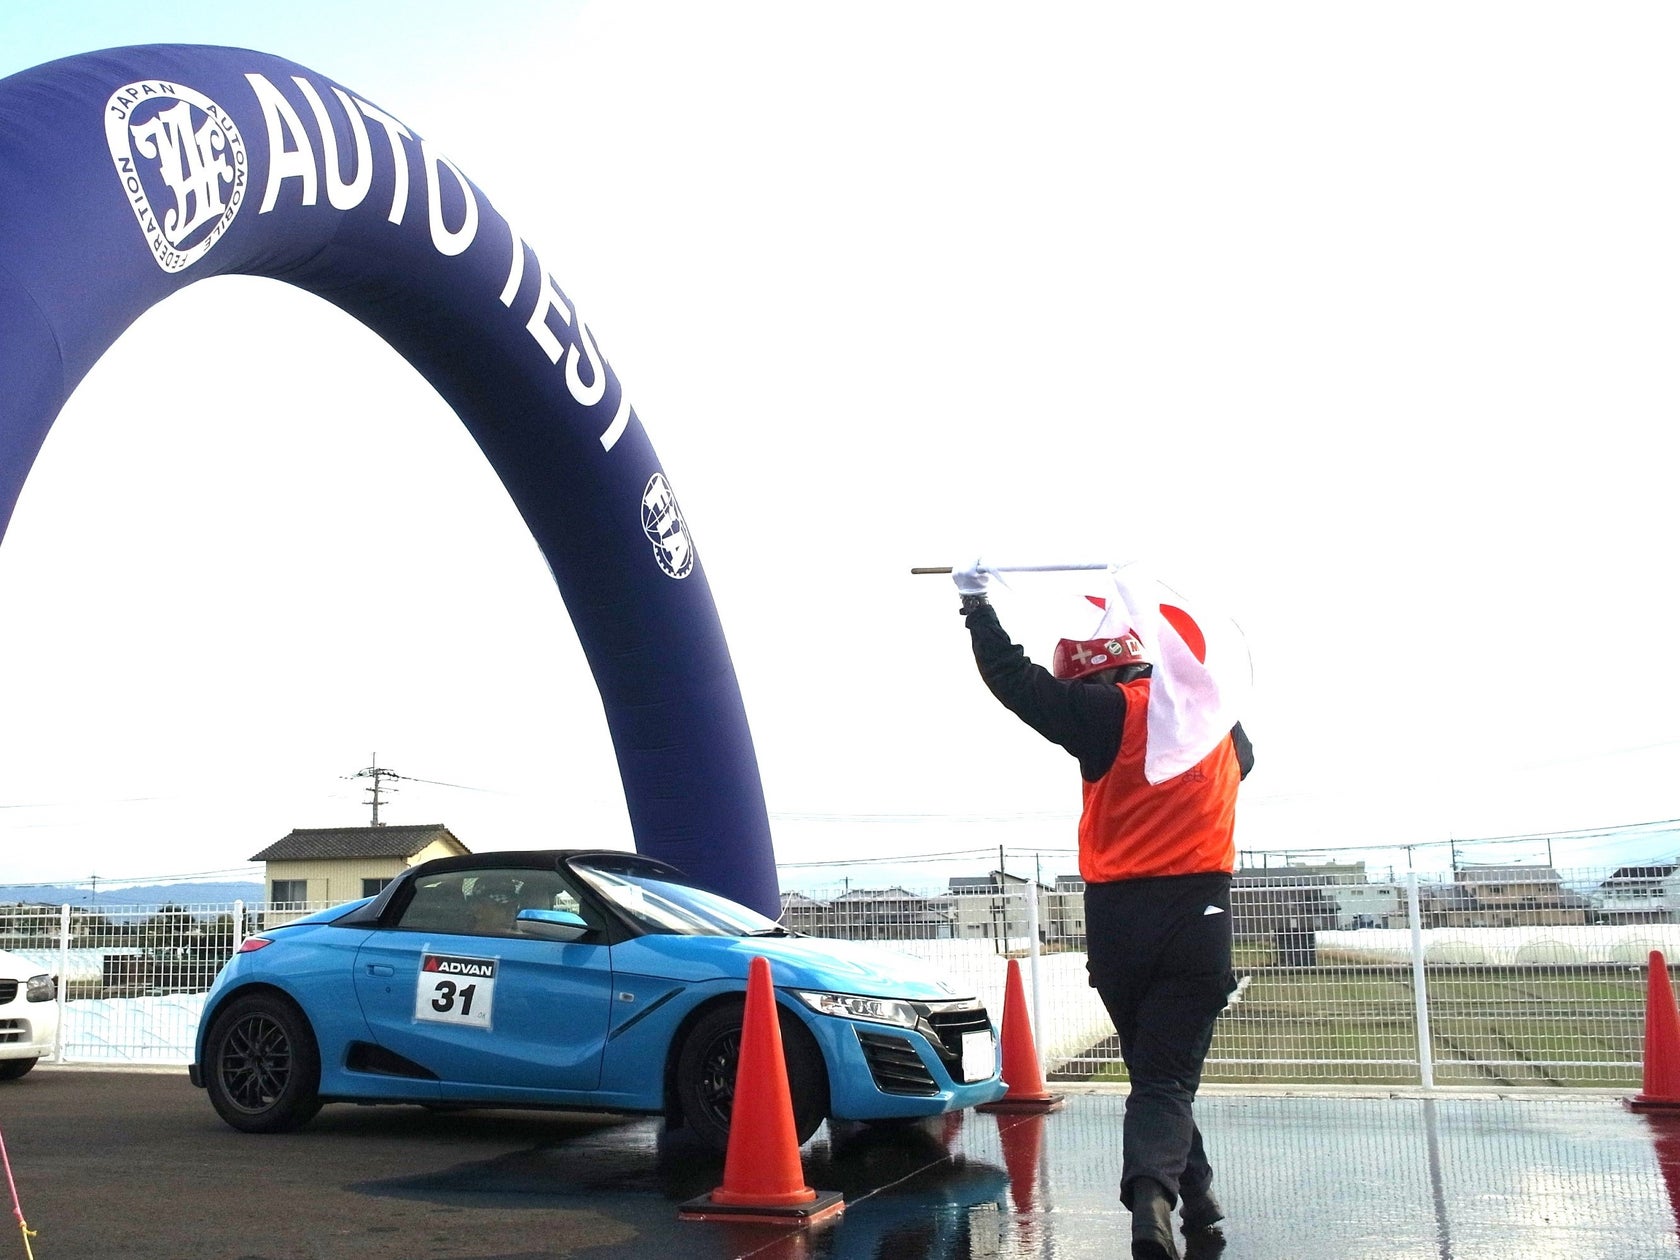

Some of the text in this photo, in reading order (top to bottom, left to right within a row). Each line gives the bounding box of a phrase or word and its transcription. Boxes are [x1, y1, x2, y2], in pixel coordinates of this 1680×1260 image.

[110, 82, 246, 269] JAPAN AUTOMOBILE FEDERATION
[244, 73, 479, 257] AUTO
[431, 980, 477, 1016] 31
[438, 961, 492, 976] ADVAN
